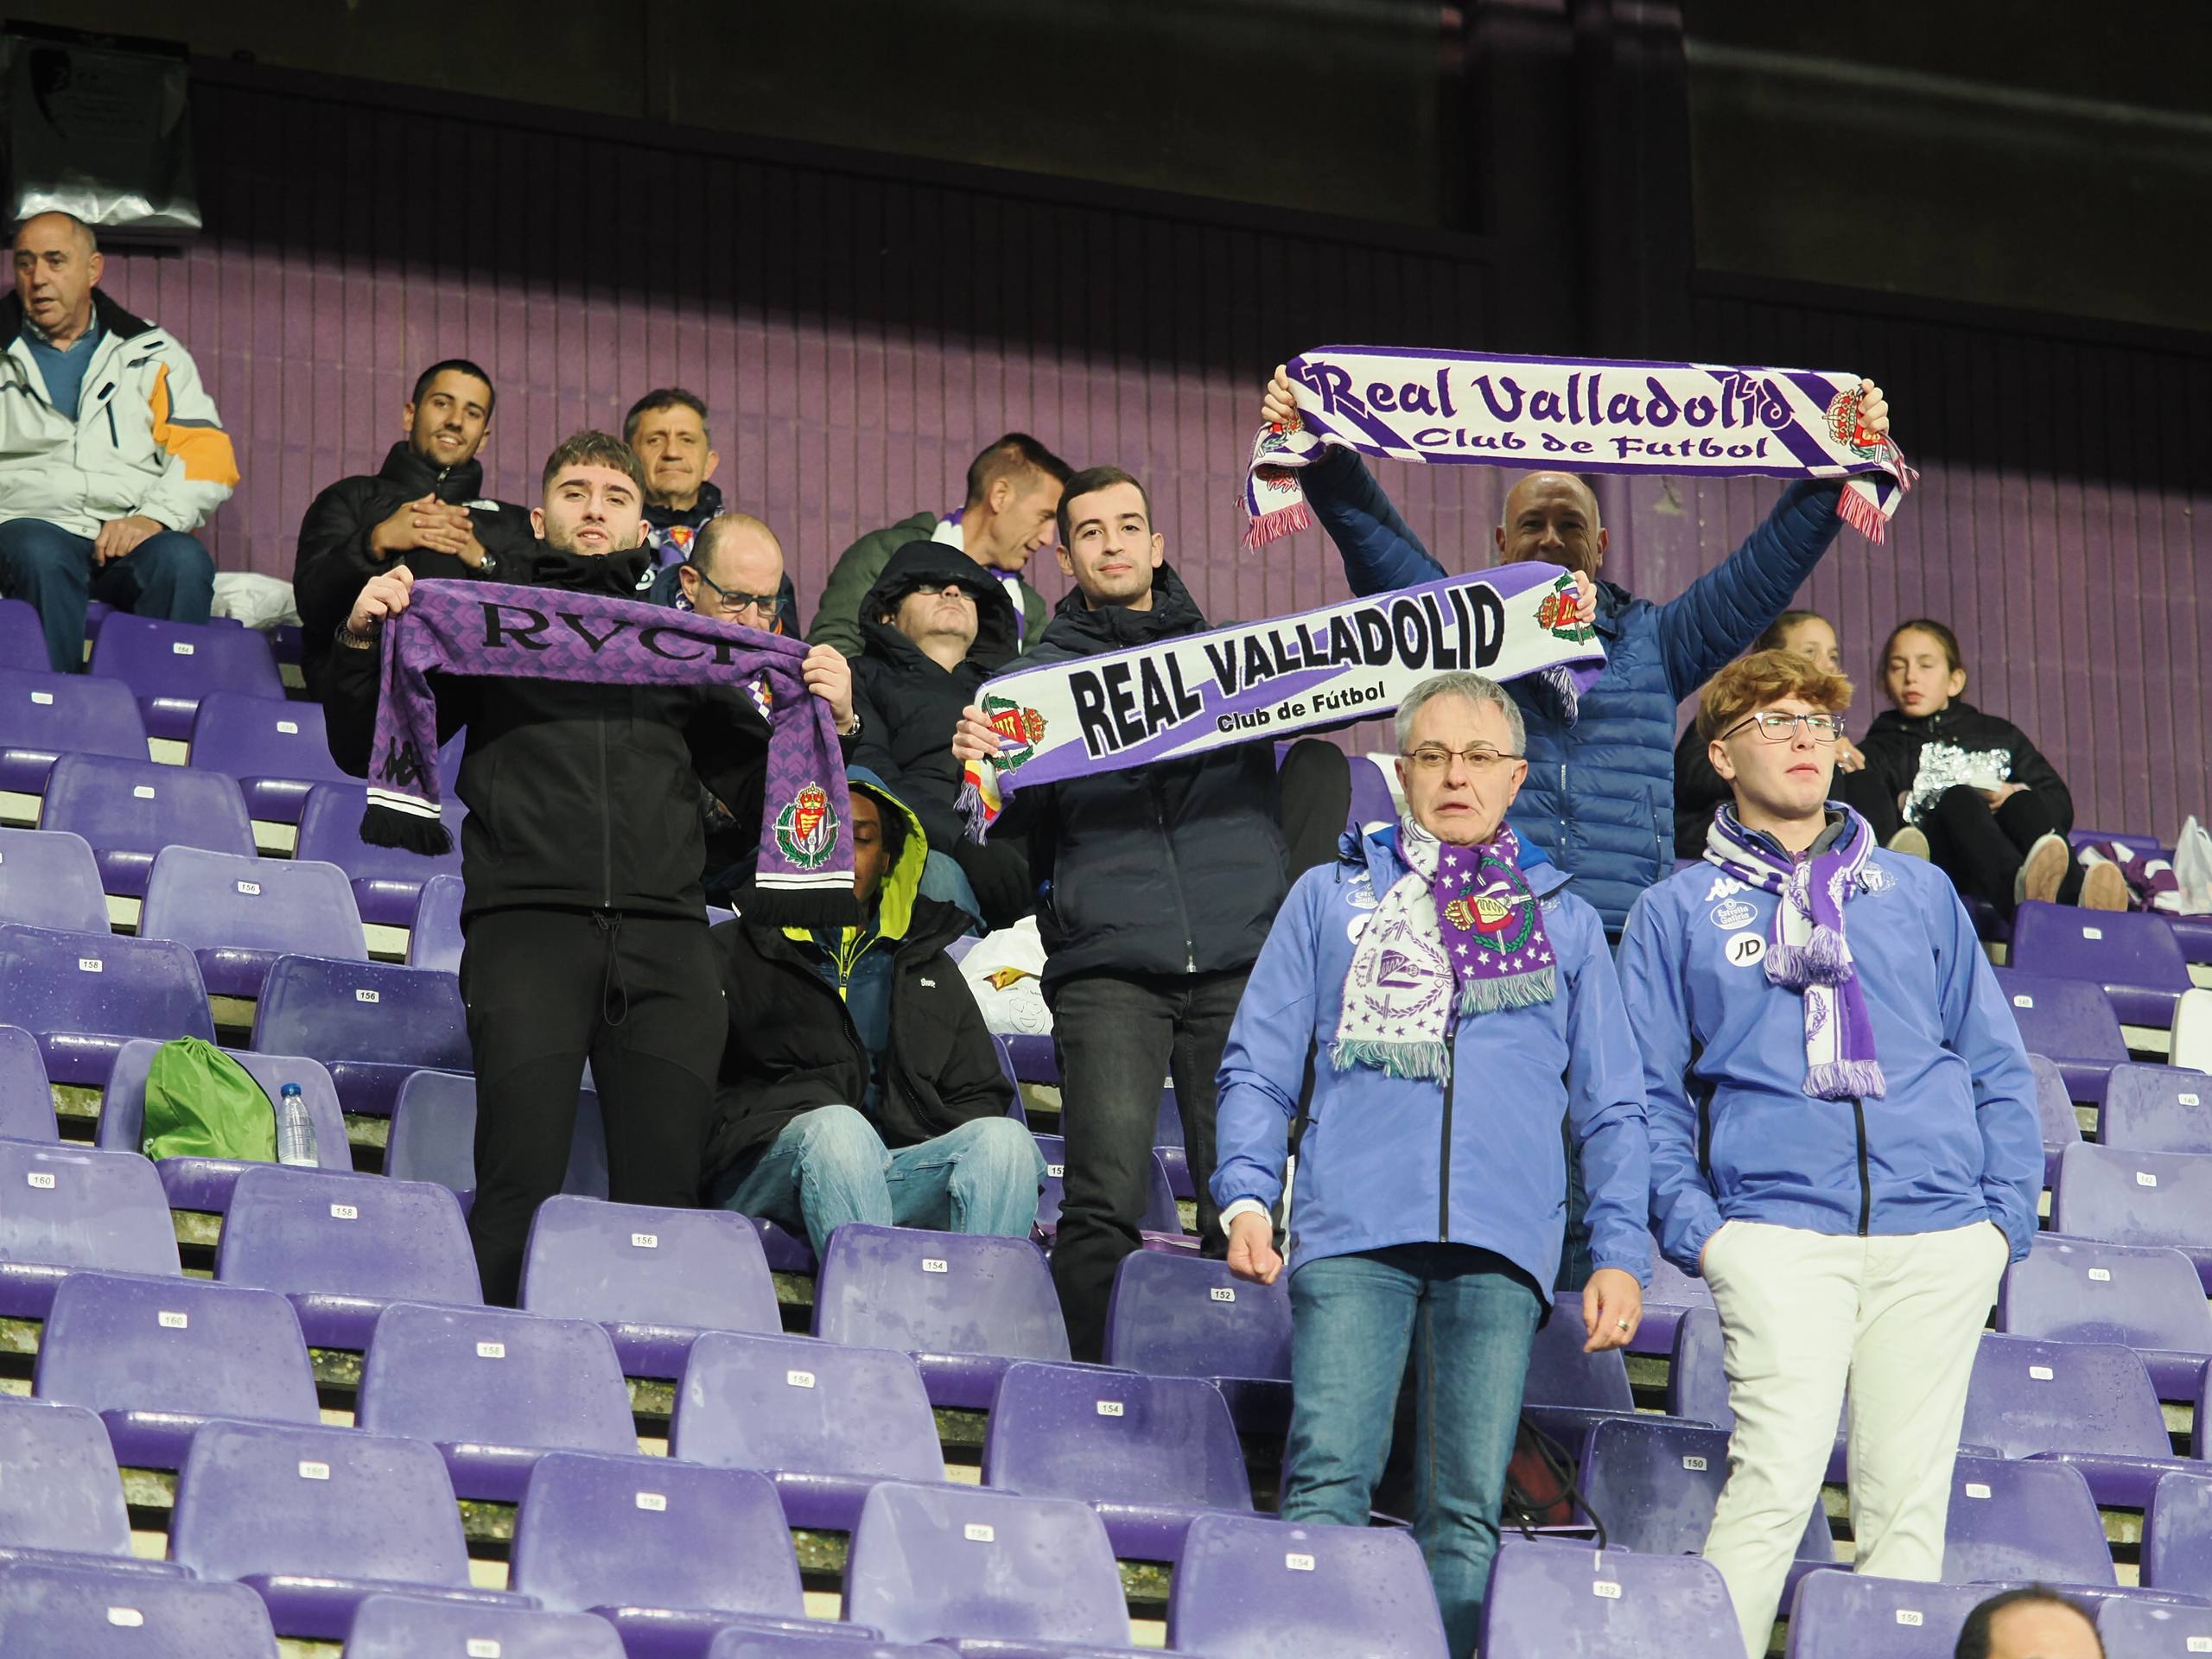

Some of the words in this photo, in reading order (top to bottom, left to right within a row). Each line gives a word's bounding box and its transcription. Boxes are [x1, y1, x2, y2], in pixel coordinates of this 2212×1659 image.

[1304, 361, 1457, 418] Real
[1471, 372, 1795, 429] Valladolid
[1413, 428, 1526, 450] Club
[1541, 432, 1594, 453] de
[1609, 435, 1769, 460] Futbol
[1069, 652, 1202, 757] REAL
[1204, 584, 1505, 696] VALLADOLID
[1217, 709, 1271, 733] Club
[1277, 702, 1306, 721] de
[1313, 681, 1386, 713] Fútbol
[1734, 939, 1761, 961] JD
[83, 961, 99, 969] 158
[361, 992, 377, 1001] 156
[1052, 1166, 1064, 1175] 15
[33, 1176, 51, 1185] 160
[335, 1207, 353, 1217] 158
[636, 1236, 653, 1245] 156
[927, 1262, 944, 1270] 154
[1214, 1290, 1231, 1300] 152
[164, 1315, 183, 1325] 160
[482, 1345, 501, 1356] 158
[792, 1375, 810, 1385] 156
[1102, 1404, 1120, 1414] 154
[1687, 1459, 1704, 1468] 150
[1599, 1585, 1618, 1596] 152
[1901, 1612, 1919, 1623] 150
